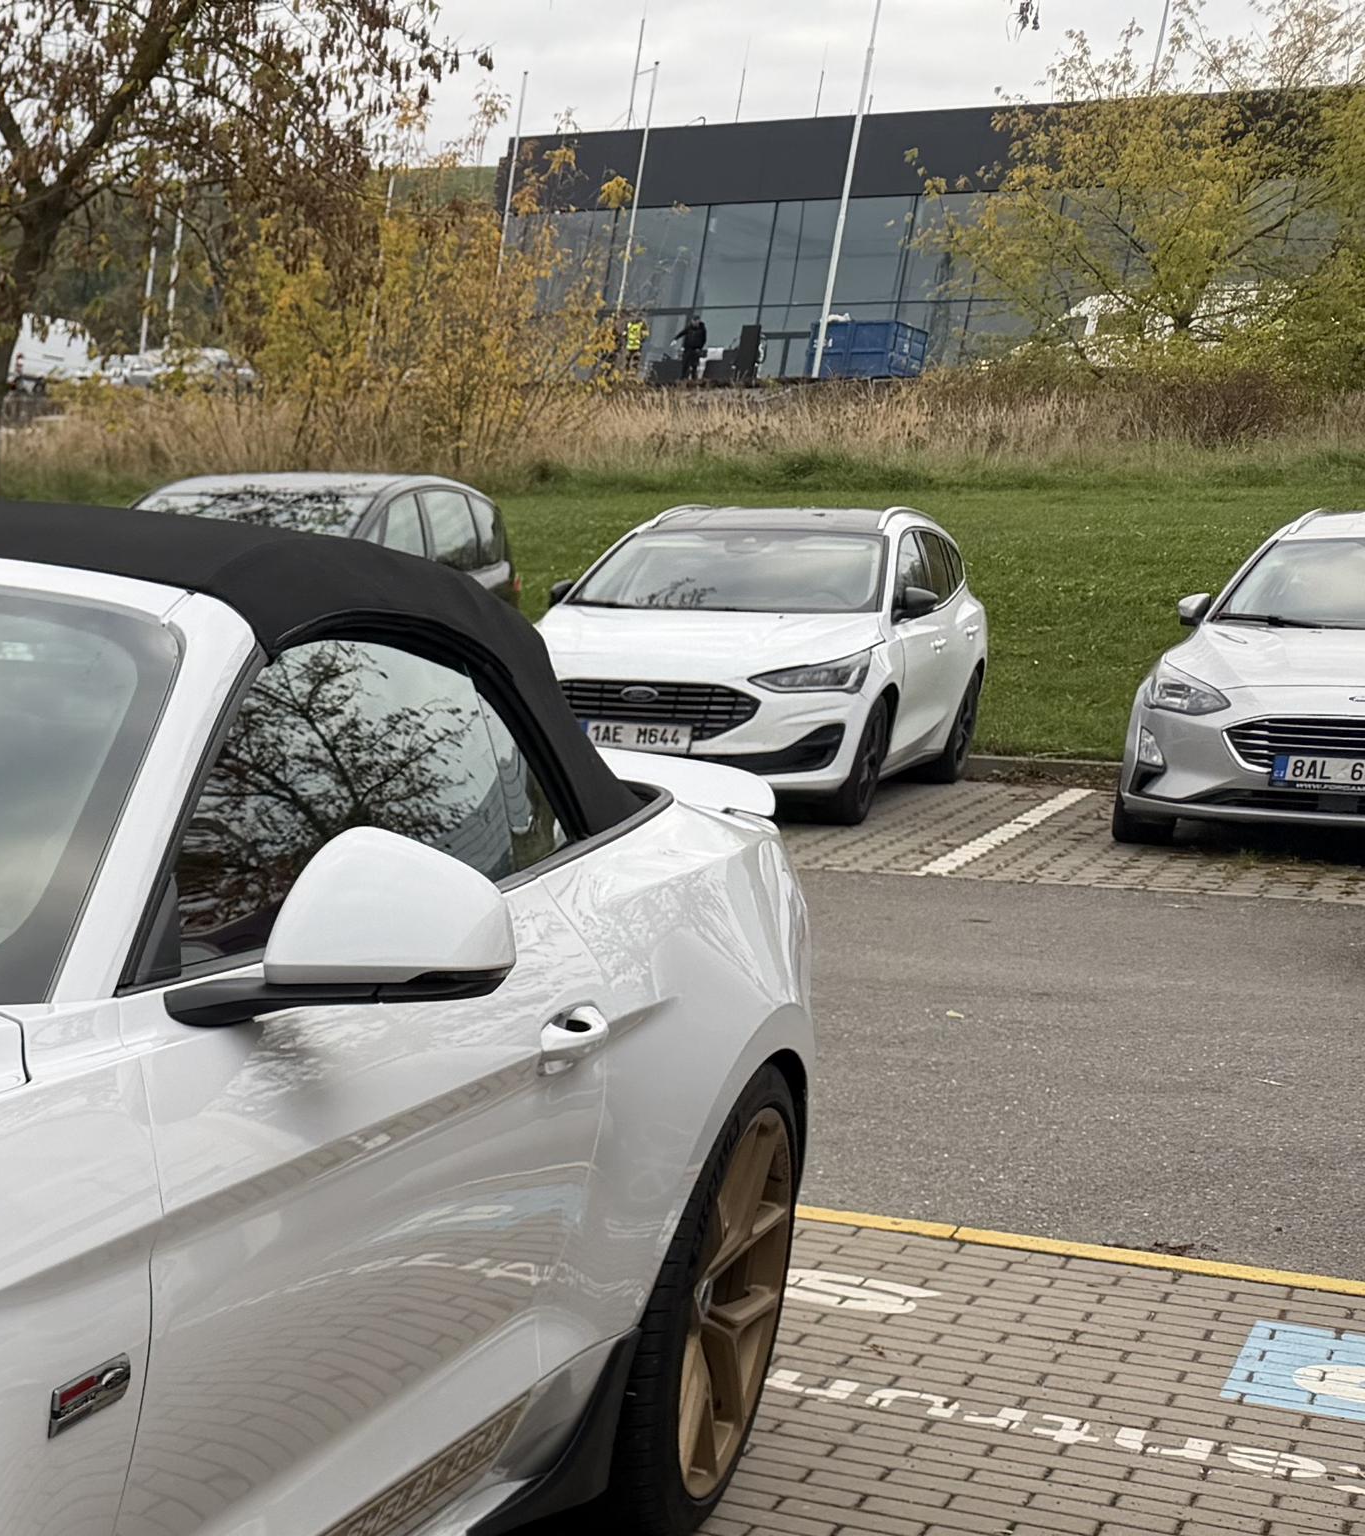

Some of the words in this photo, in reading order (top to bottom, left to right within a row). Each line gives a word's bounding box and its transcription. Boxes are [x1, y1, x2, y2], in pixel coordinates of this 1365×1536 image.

[592, 725, 624, 744] 1AE
[636, 727, 681, 746] M644
[1292, 759, 1331, 780] 8AL
